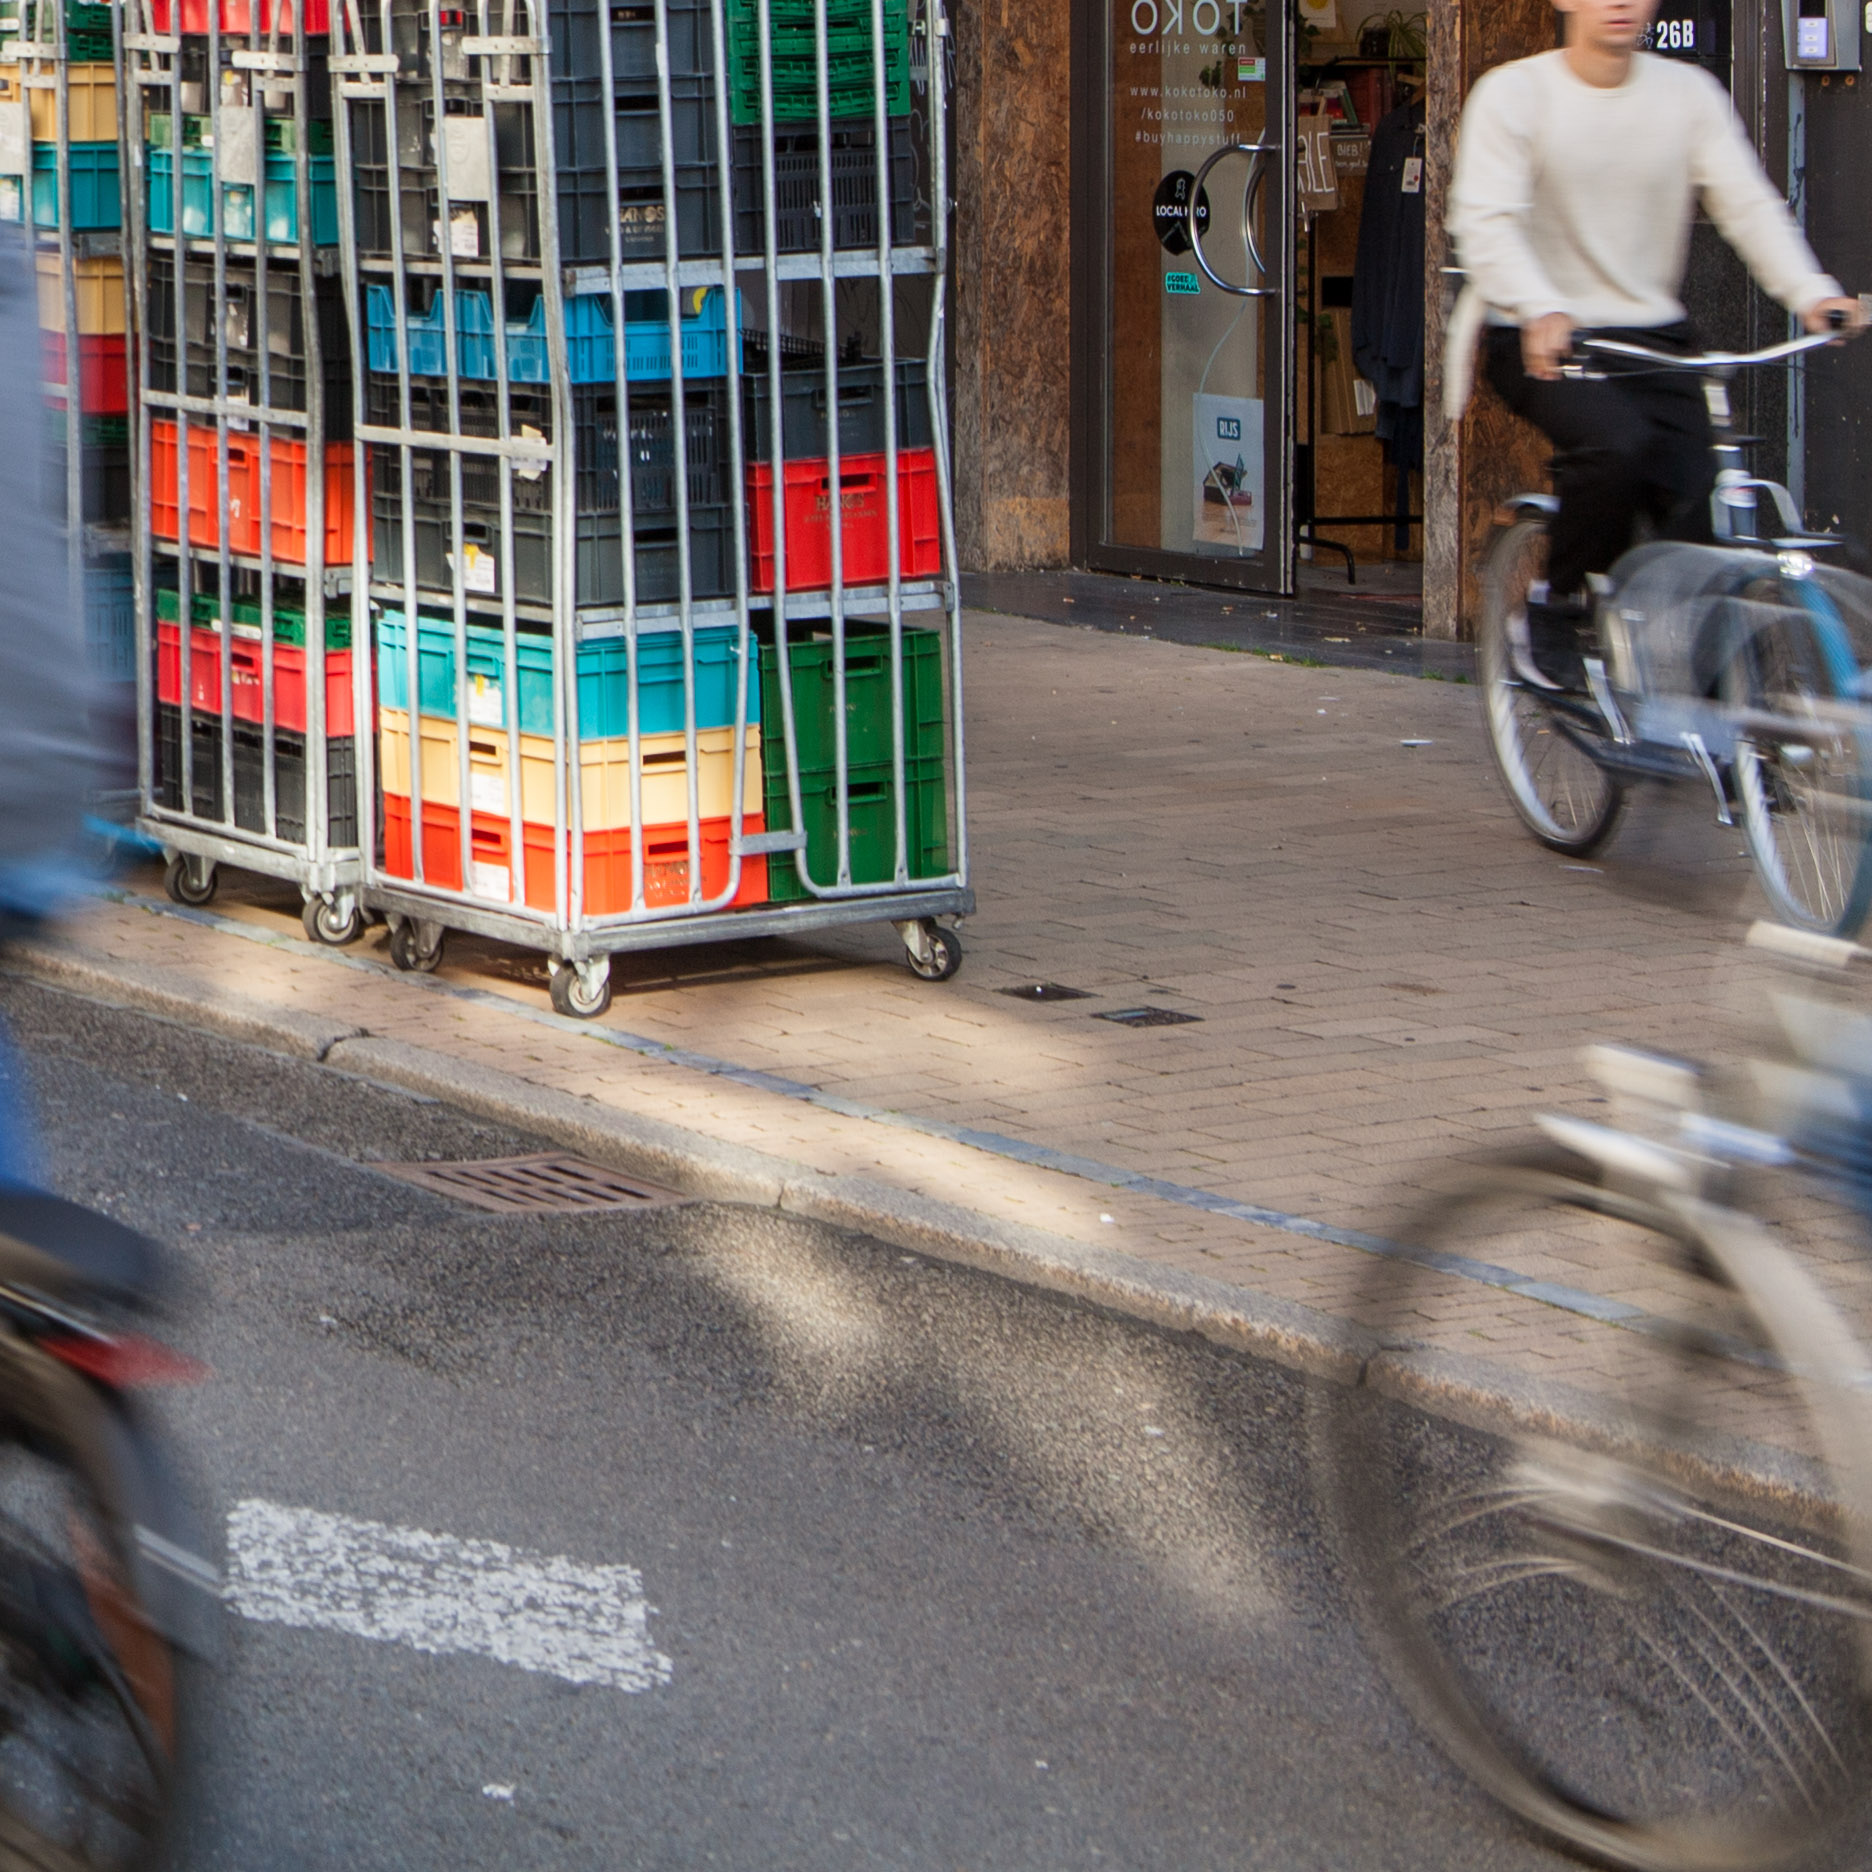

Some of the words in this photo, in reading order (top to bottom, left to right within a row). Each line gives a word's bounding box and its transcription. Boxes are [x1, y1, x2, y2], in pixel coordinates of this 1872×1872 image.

[1656, 19, 1694, 49] 26B
[1129, 40, 1190, 58] eerlijke
[1199, 39, 1246, 55] waren
[1156, 206, 1182, 217] LOCAL
[1219, 419, 1239, 438] RIJS
